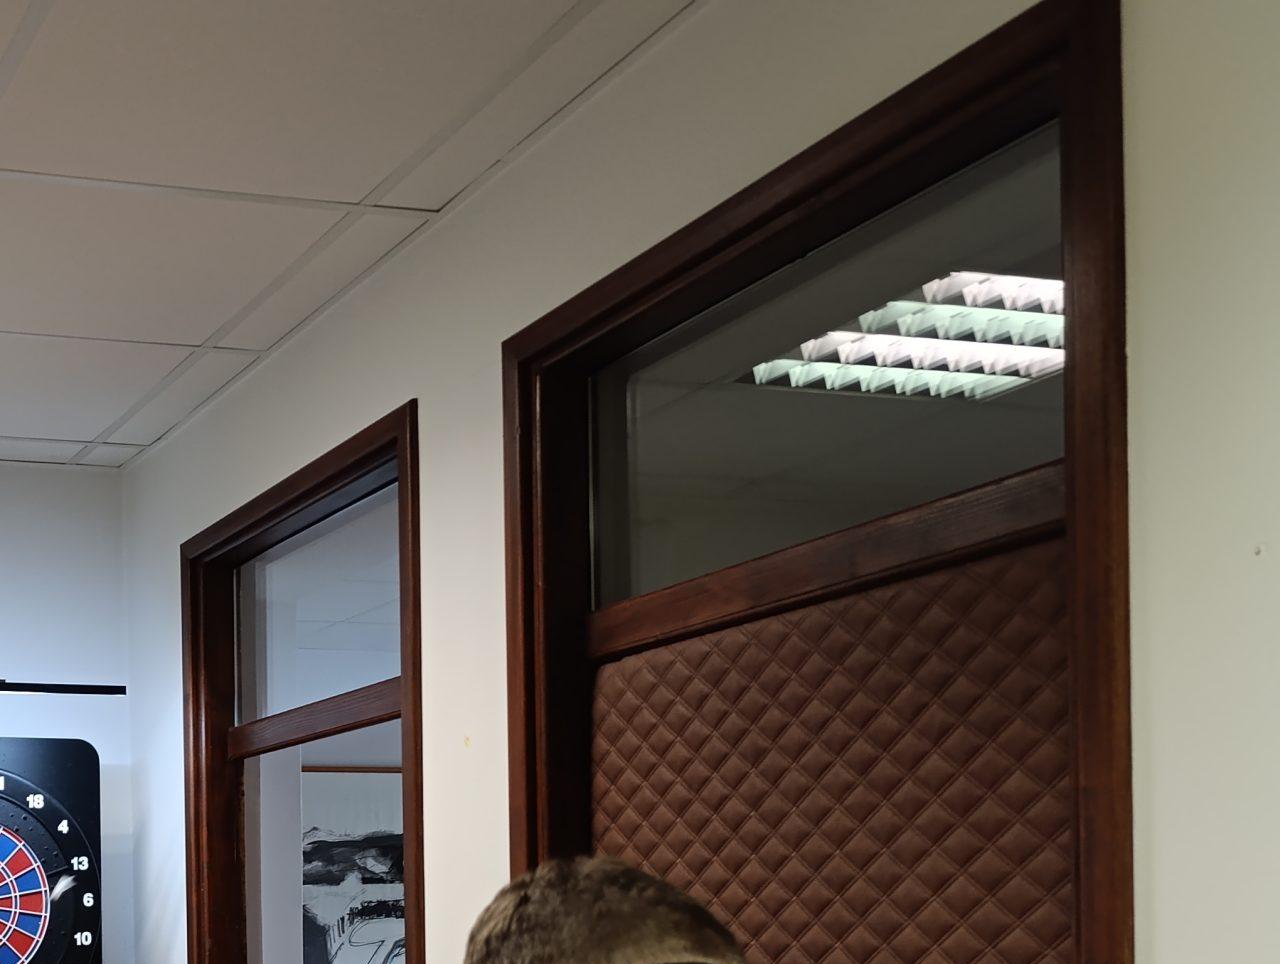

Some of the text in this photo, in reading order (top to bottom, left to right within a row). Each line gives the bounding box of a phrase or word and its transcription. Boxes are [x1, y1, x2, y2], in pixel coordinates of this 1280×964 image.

[26, 794, 44, 808] 18
[57, 820, 69, 833] 4
[70, 857, 89, 870] 13
[83, 893, 94, 906] 6
[74, 932, 92, 945] 10
